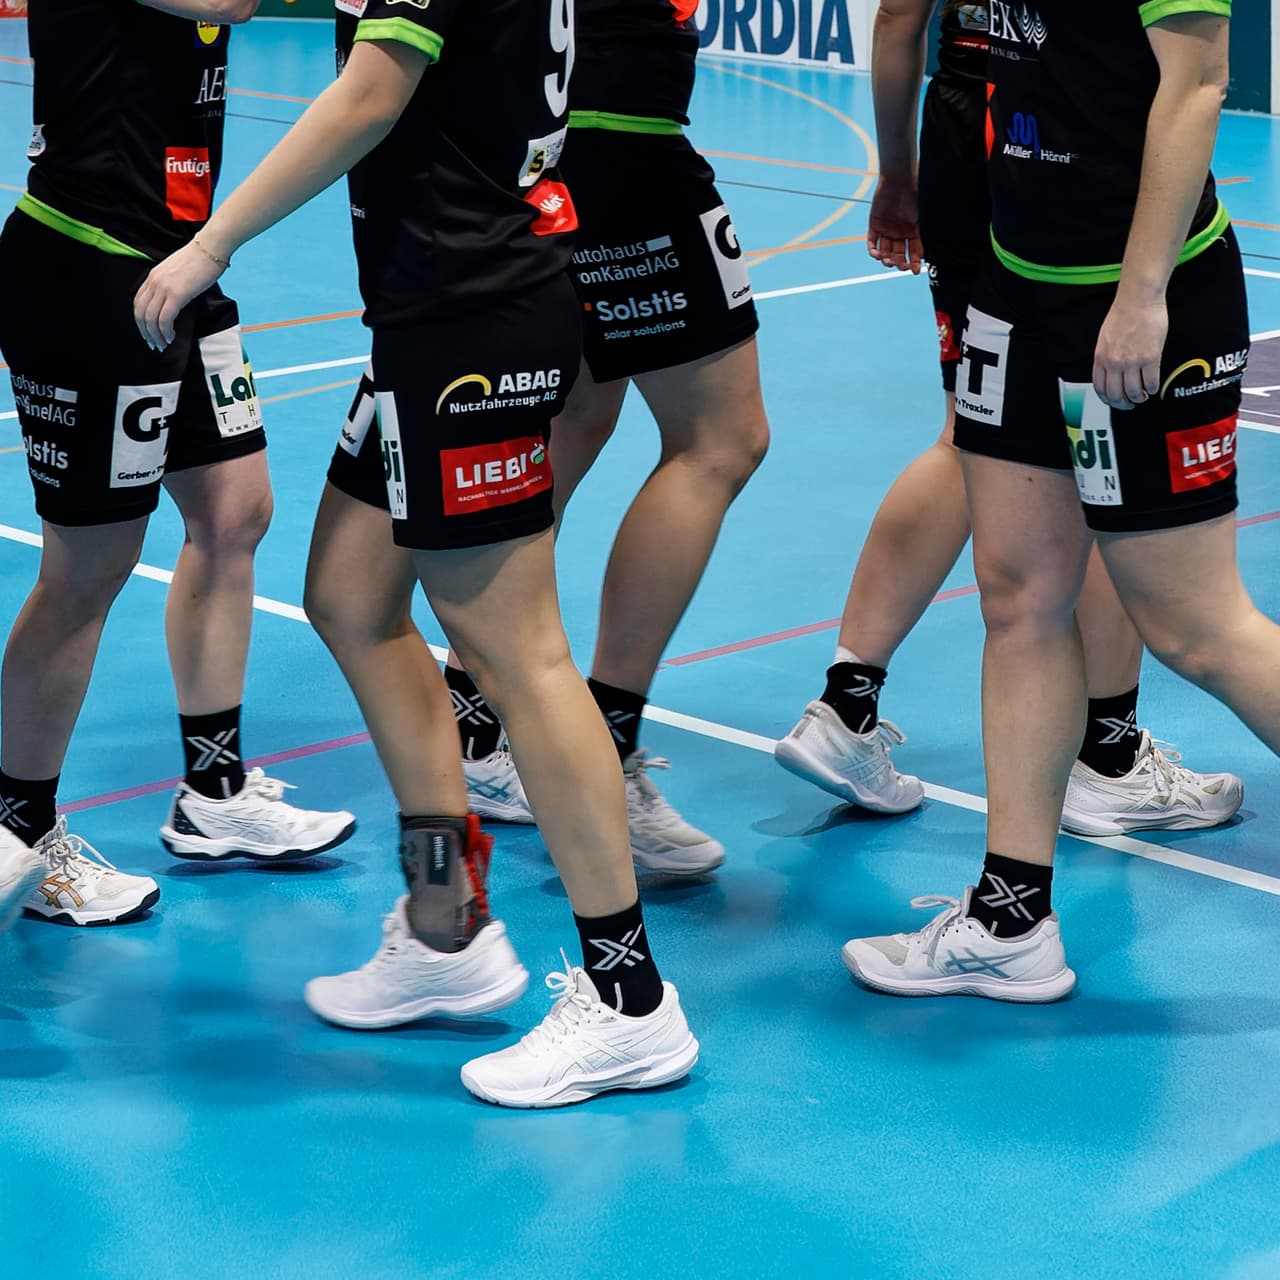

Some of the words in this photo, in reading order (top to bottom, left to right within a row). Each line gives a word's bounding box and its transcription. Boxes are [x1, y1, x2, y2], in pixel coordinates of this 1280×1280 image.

[577, 251, 680, 284] onKänelAG
[596, 290, 688, 321] Solstis
[604, 328, 631, 340] solar
[634, 320, 686, 337] solutions
[498, 369, 560, 394] ABAG
[449, 394, 541, 414] Nutzfahrzeuge
[455, 453, 527, 489] LIEBI
